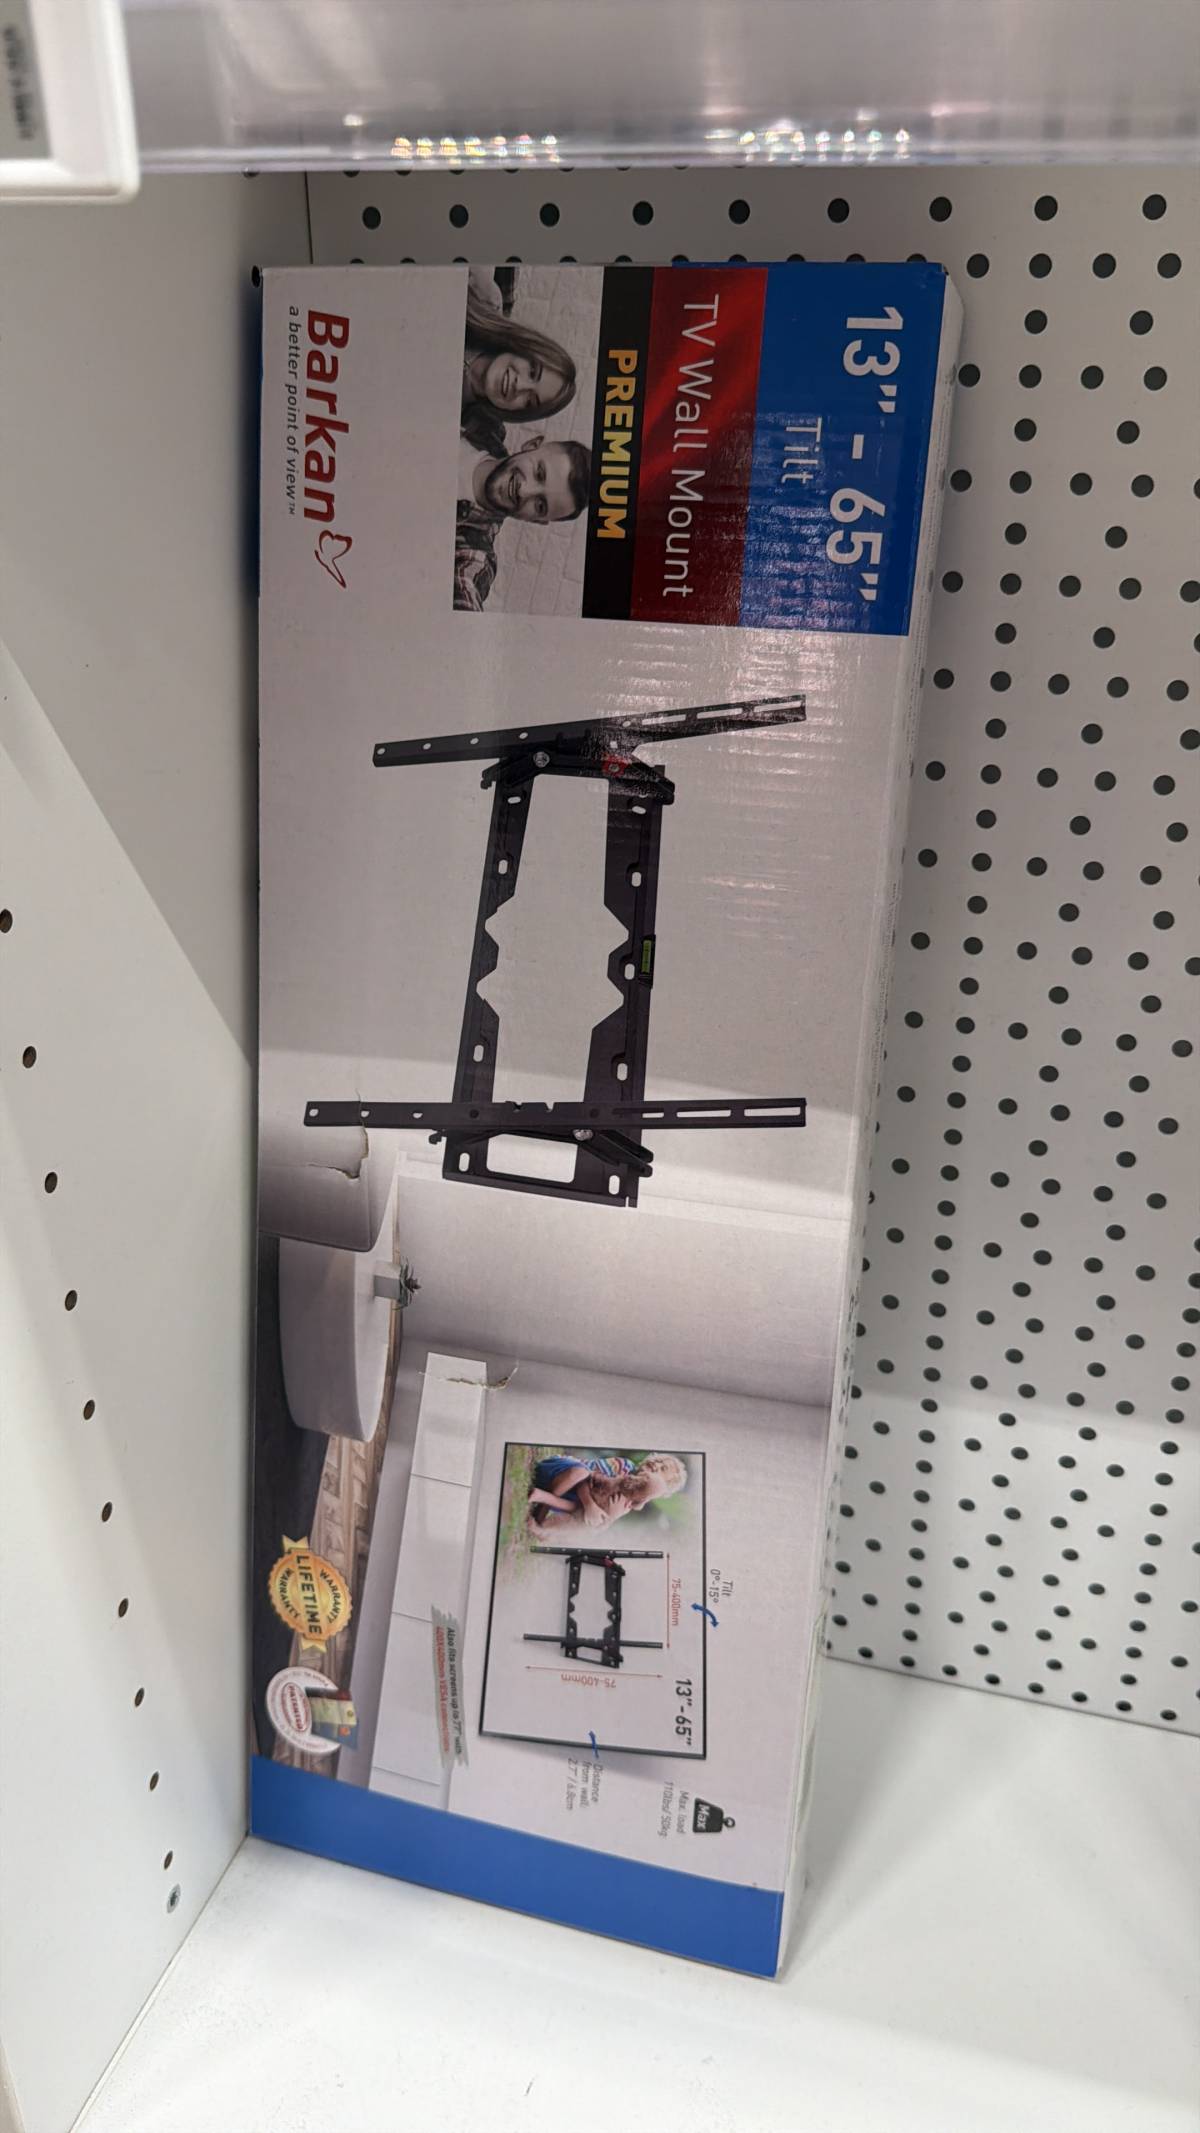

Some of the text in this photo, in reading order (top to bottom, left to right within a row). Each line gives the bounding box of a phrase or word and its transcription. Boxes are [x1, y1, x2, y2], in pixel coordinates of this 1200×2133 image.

[289, 305, 299, 316] a
[287, 321, 302, 379] better
[843, 306, 904, 413] 13"
[285, 384, 300, 429] point
[304, 310, 350, 523] Barkan
[286, 436, 299, 454] of
[596, 349, 639, 539] PREMIUM
[662, 294, 719, 598] TV Wall Mount
[781, 417, 823, 484] Tilt
[826, 487, 887, 601] 65"
[277, 1568, 300, 1619] WARRANTY
[296, 1555, 322, 1635] LIFETIME
[319, 1568, 342, 1624] WARRANTY
[671, 1578, 682, 1626] 75-400mm
[722, 1580, 734, 1597] Tilt
[447, 1627, 456, 1646] Also
[449, 1648, 457, 1662] fits
[449, 1662, 458, 1697] screens
[561, 1673, 617, 1688] 75-400mm
[287, 1684, 304, 1730] PATENTED
[450, 1697, 459, 1710] up
[582, 1760, 592, 1783] from
[591, 1763, 603, 1802] Distance
[676, 1814, 687, 1834] load
[697, 1804, 710, 1830] Max
